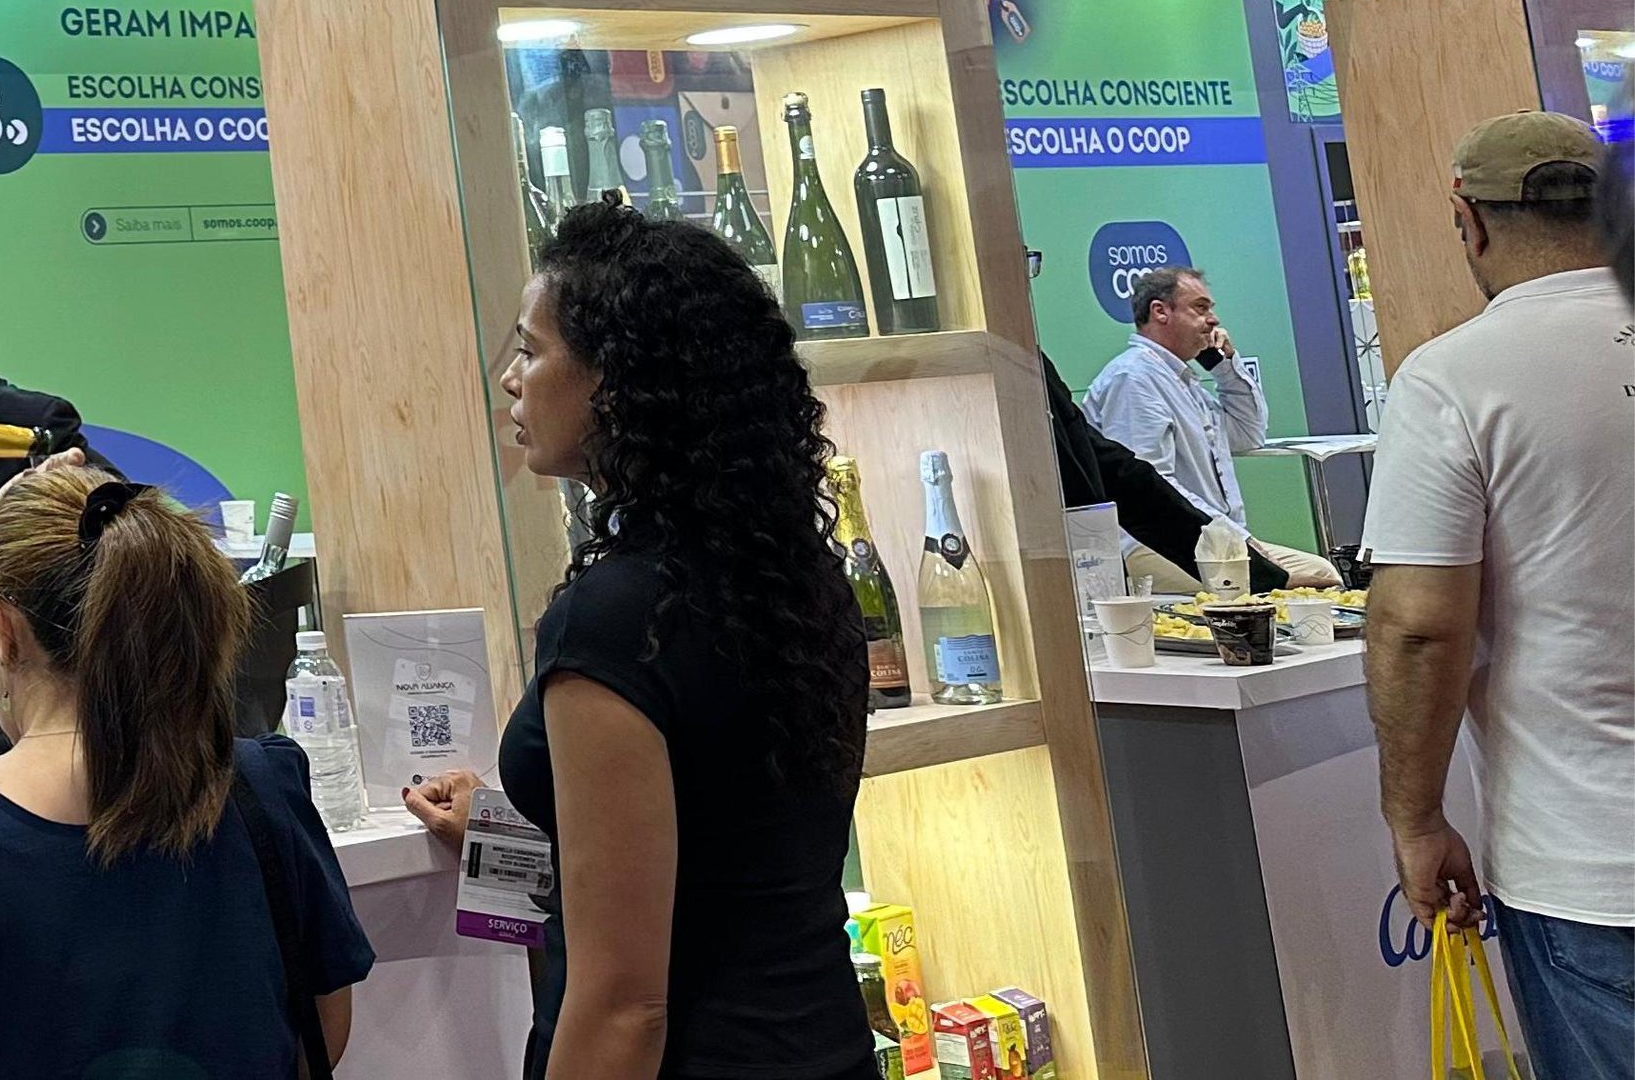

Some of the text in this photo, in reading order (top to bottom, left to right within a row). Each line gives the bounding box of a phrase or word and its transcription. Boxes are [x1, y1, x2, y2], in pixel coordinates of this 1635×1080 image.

[60, 7, 257, 39] GERAM IMPA
[67, 75, 263, 100] ESCOLHA CONS
[1000, 79, 1233, 106] SCOLHA CONSCIENTE
[71, 117, 192, 142] ESCOLHA
[194, 117, 214, 142] O
[1106, 126, 1125, 154] O
[1127, 126, 1191, 154] COOP
[115, 218, 182, 232] Saiba mais
[1107, 244, 1168, 266] somos
[396, 682, 419, 691] NOVA
[487, 918, 528, 935] SERVIÇO
